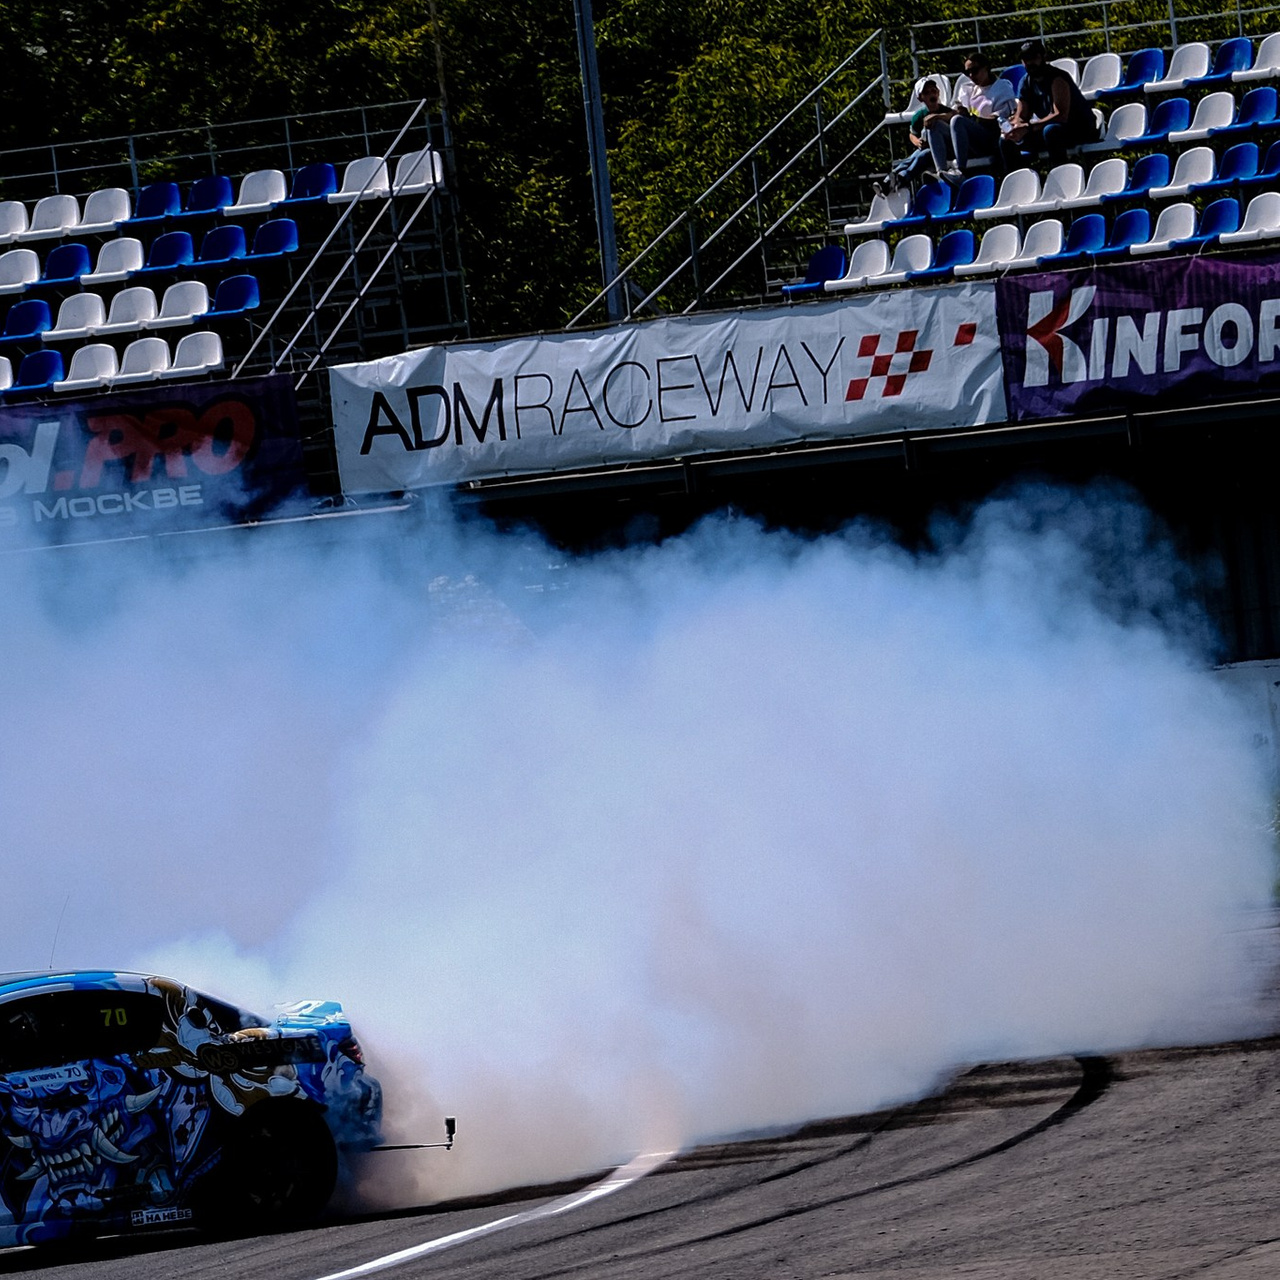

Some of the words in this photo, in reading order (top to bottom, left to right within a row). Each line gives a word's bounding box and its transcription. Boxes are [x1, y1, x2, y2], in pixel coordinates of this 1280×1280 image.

[100, 1007, 128, 1027] 70
[235, 1038, 321, 1056] WESTGATE
[64, 1067, 81, 1079] 70
